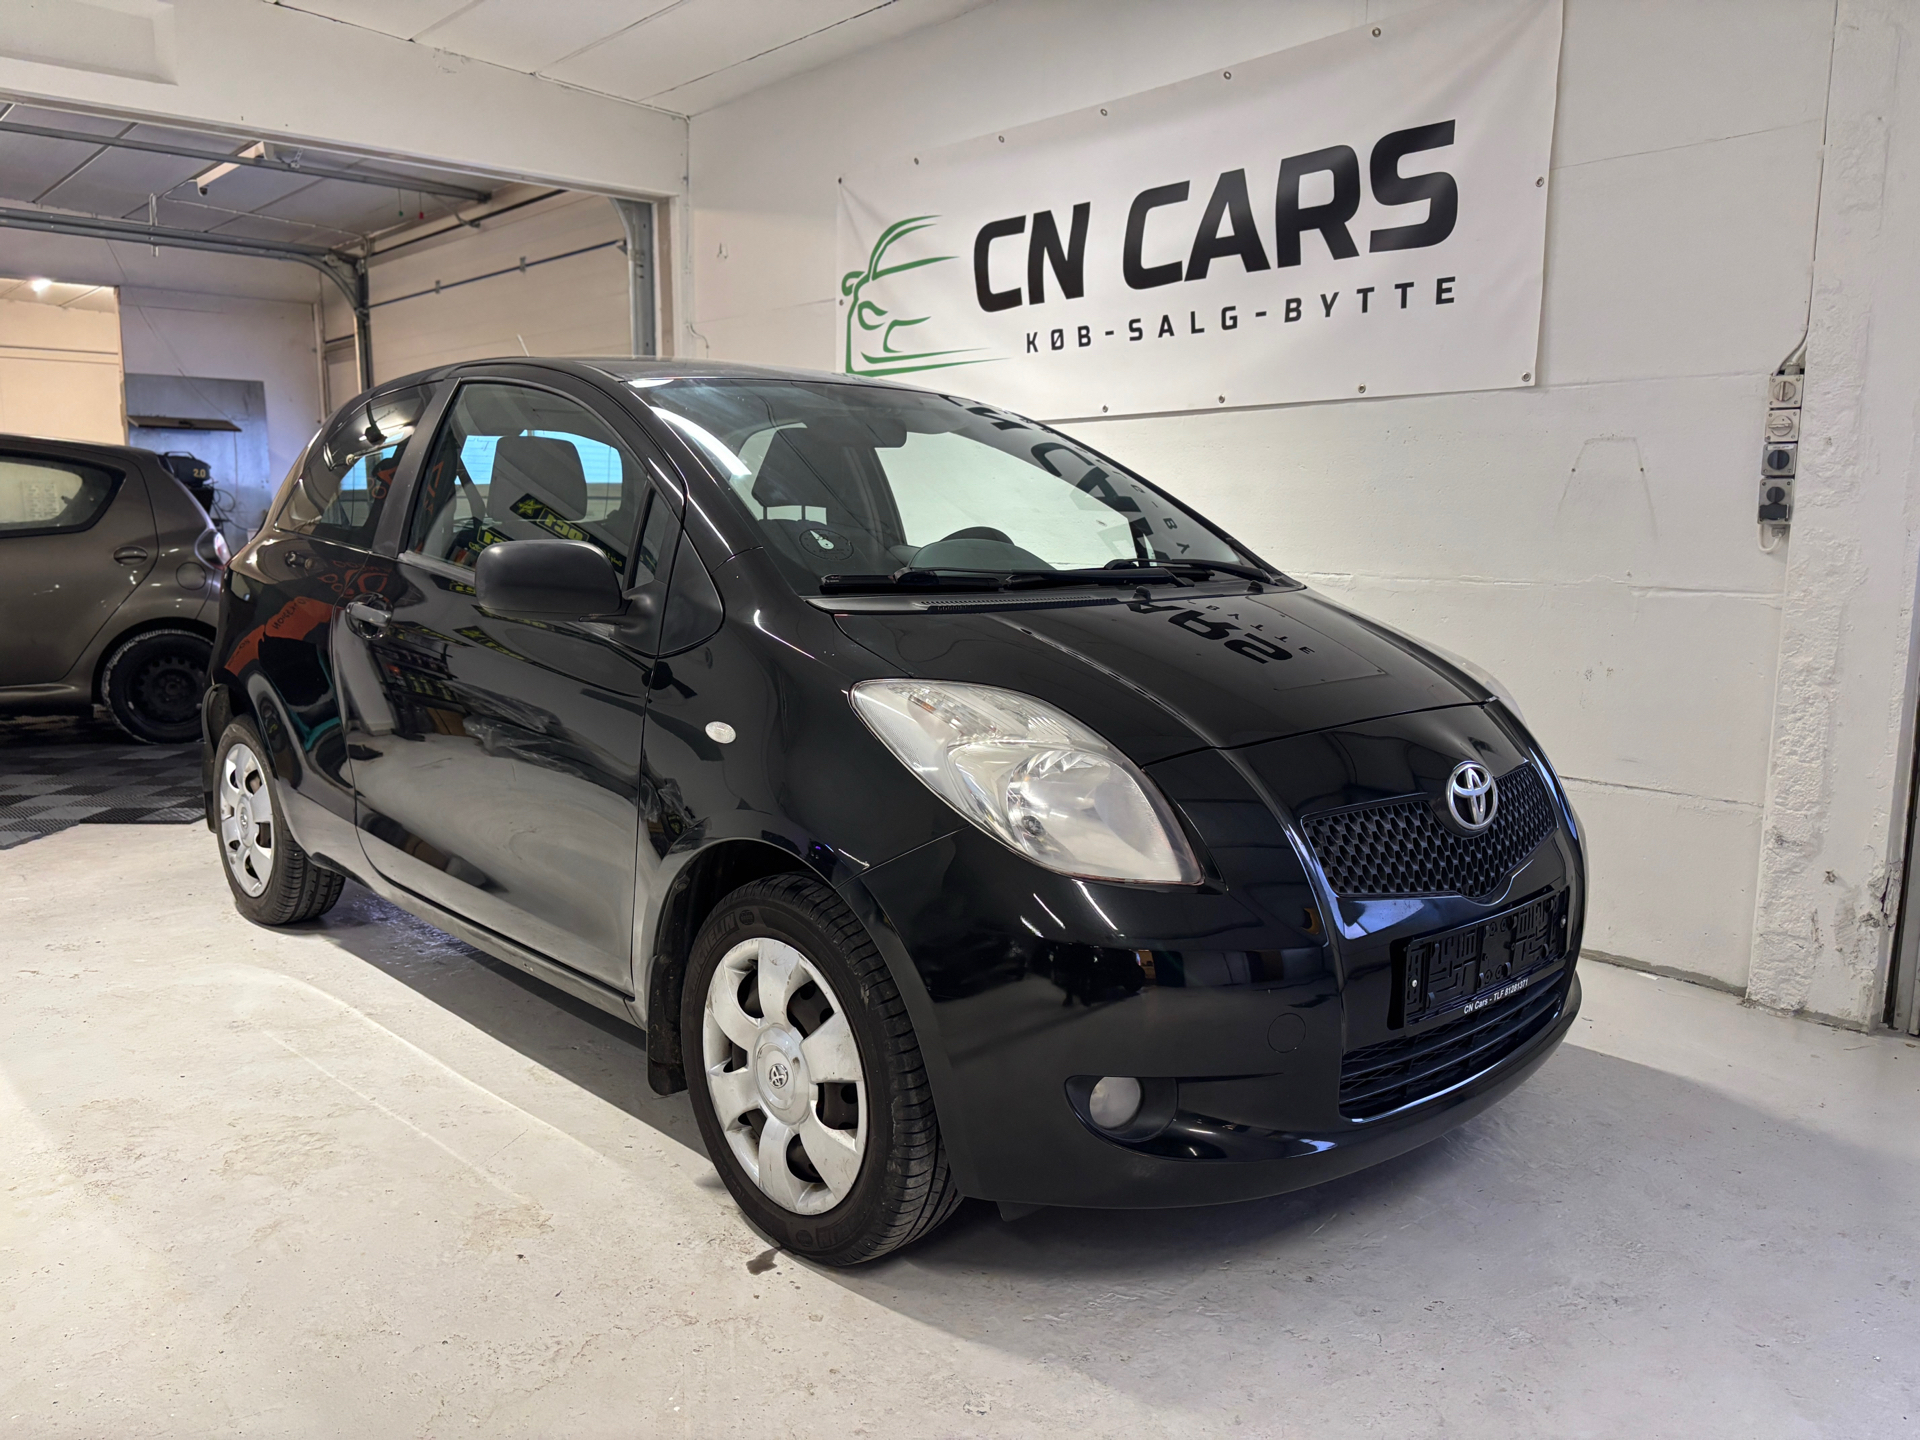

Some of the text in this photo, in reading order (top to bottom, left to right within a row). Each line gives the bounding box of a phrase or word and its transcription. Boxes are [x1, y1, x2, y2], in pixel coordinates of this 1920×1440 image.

[973, 119, 1459, 313] CN CARS
[1463, 1002, 1474, 1014] CN
[1474, 998, 1488, 1010] Cars
[1493, 989, 1505, 1001] TLF
[1504, 978, 1529, 996] 81281371
